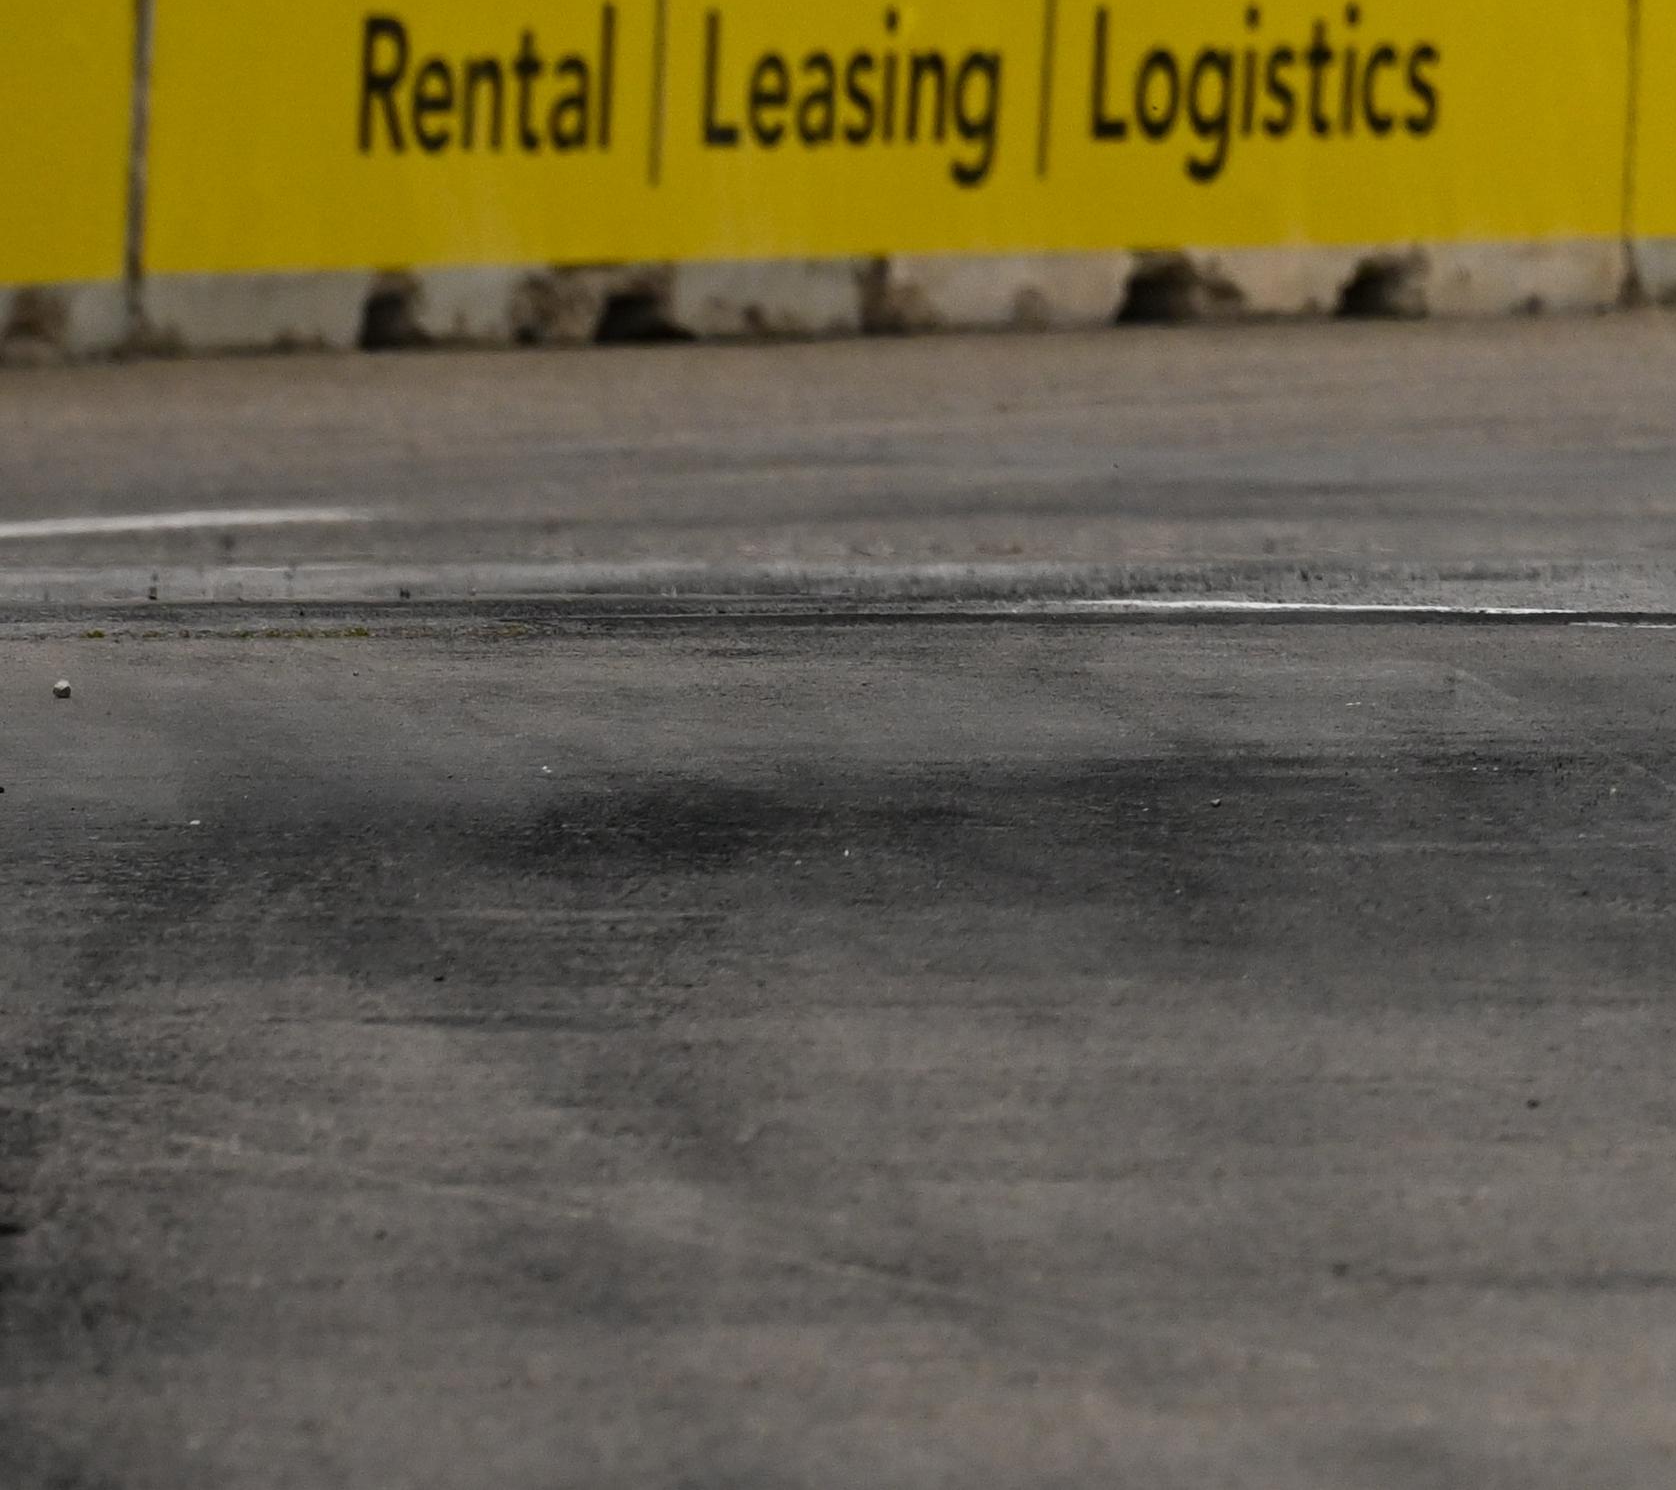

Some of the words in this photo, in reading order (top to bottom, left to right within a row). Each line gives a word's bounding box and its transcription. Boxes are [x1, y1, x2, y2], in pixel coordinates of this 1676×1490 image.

[357, 1, 616, 155] Rental
[702, 8, 1002, 188] Leasing
[1089, 2, 1441, 184] Logistics
